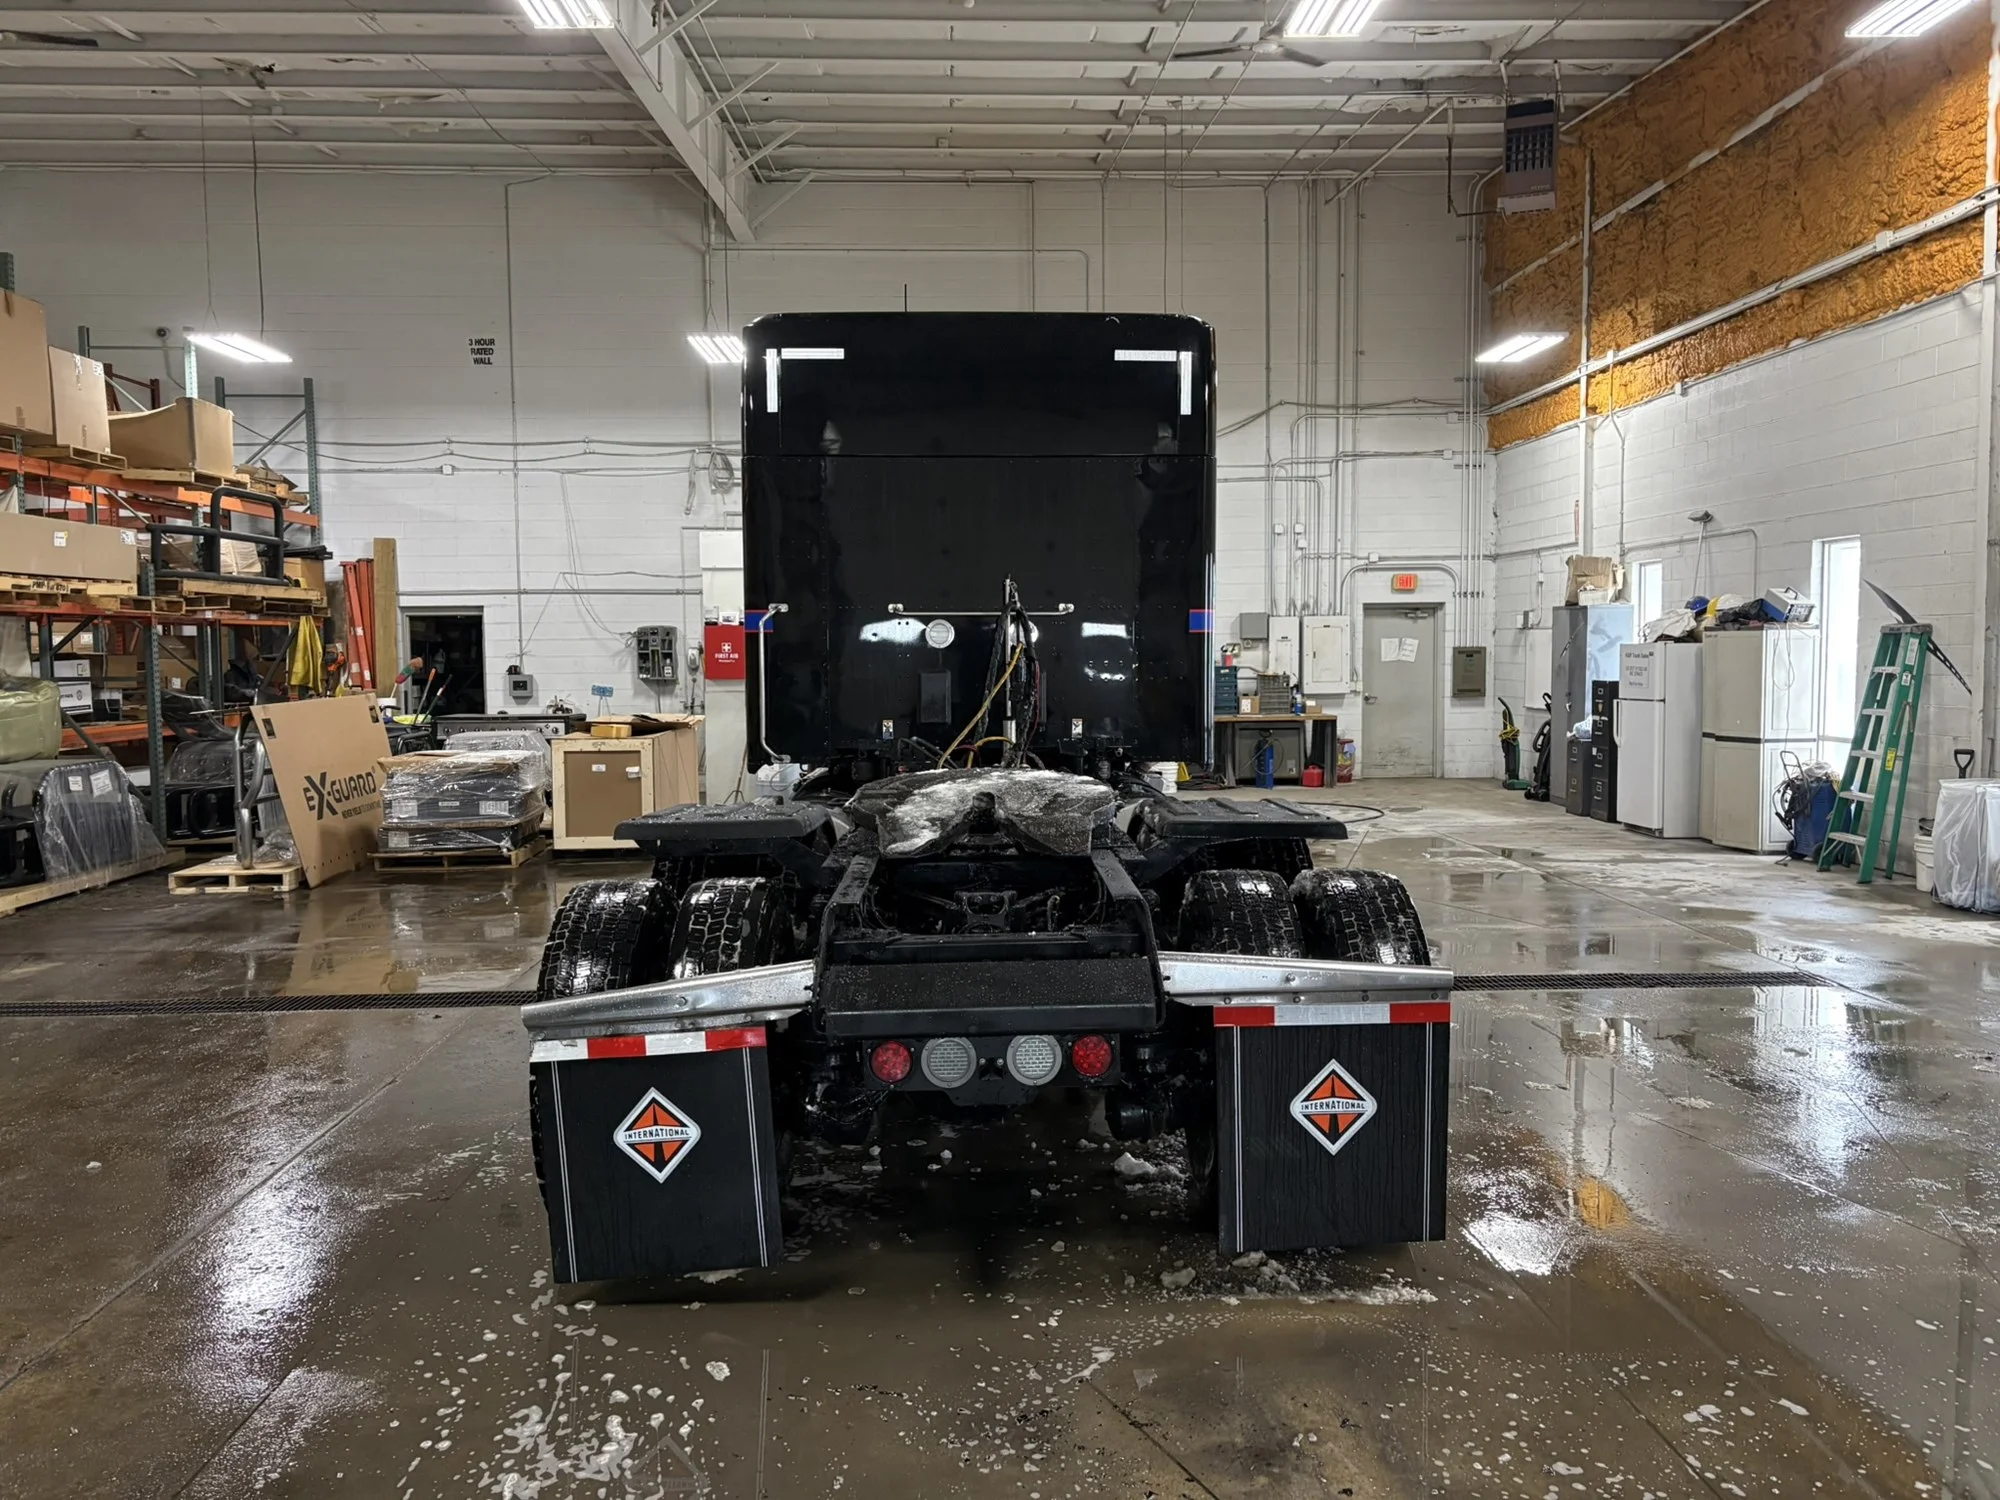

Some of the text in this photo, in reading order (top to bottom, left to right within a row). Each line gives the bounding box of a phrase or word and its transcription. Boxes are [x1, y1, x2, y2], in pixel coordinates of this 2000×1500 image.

[468, 338, 496, 346] 3 HOUR
[470, 347, 494, 356] RATED
[472, 356, 493, 365] WALL
[303, 771, 377, 821] EX-GUARD
[1301, 1100, 1365, 1111] INTERNATIONAL
[624, 1128, 690, 1140] INTERNATIONAL
